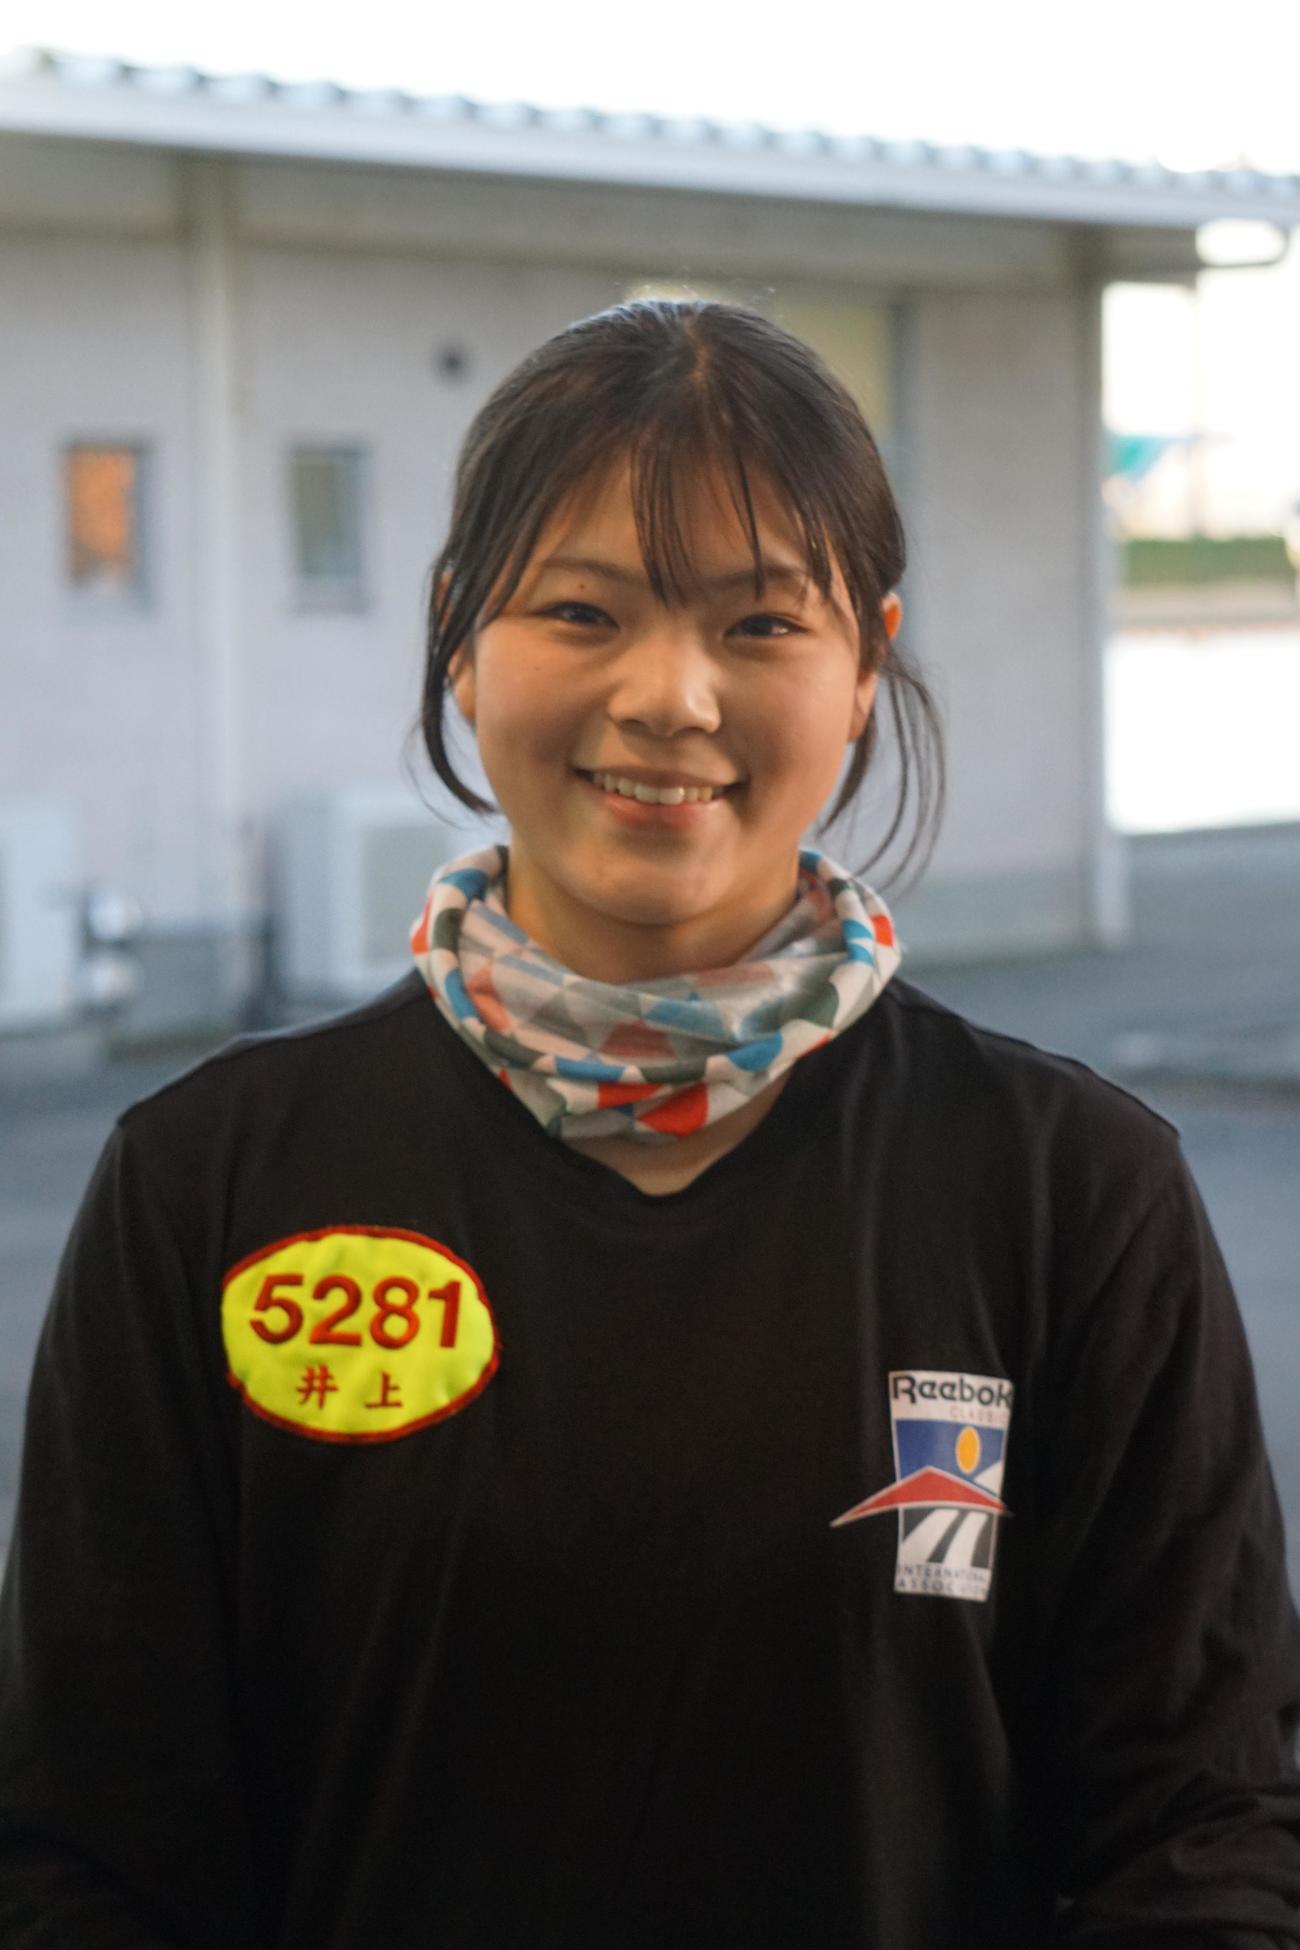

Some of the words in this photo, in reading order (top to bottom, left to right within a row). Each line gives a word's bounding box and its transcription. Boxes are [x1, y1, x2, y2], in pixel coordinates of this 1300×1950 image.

[250, 1274, 462, 1350] 5281
[296, 1363, 404, 1410] 井上
[893, 1375, 1013, 1408] Reebok
